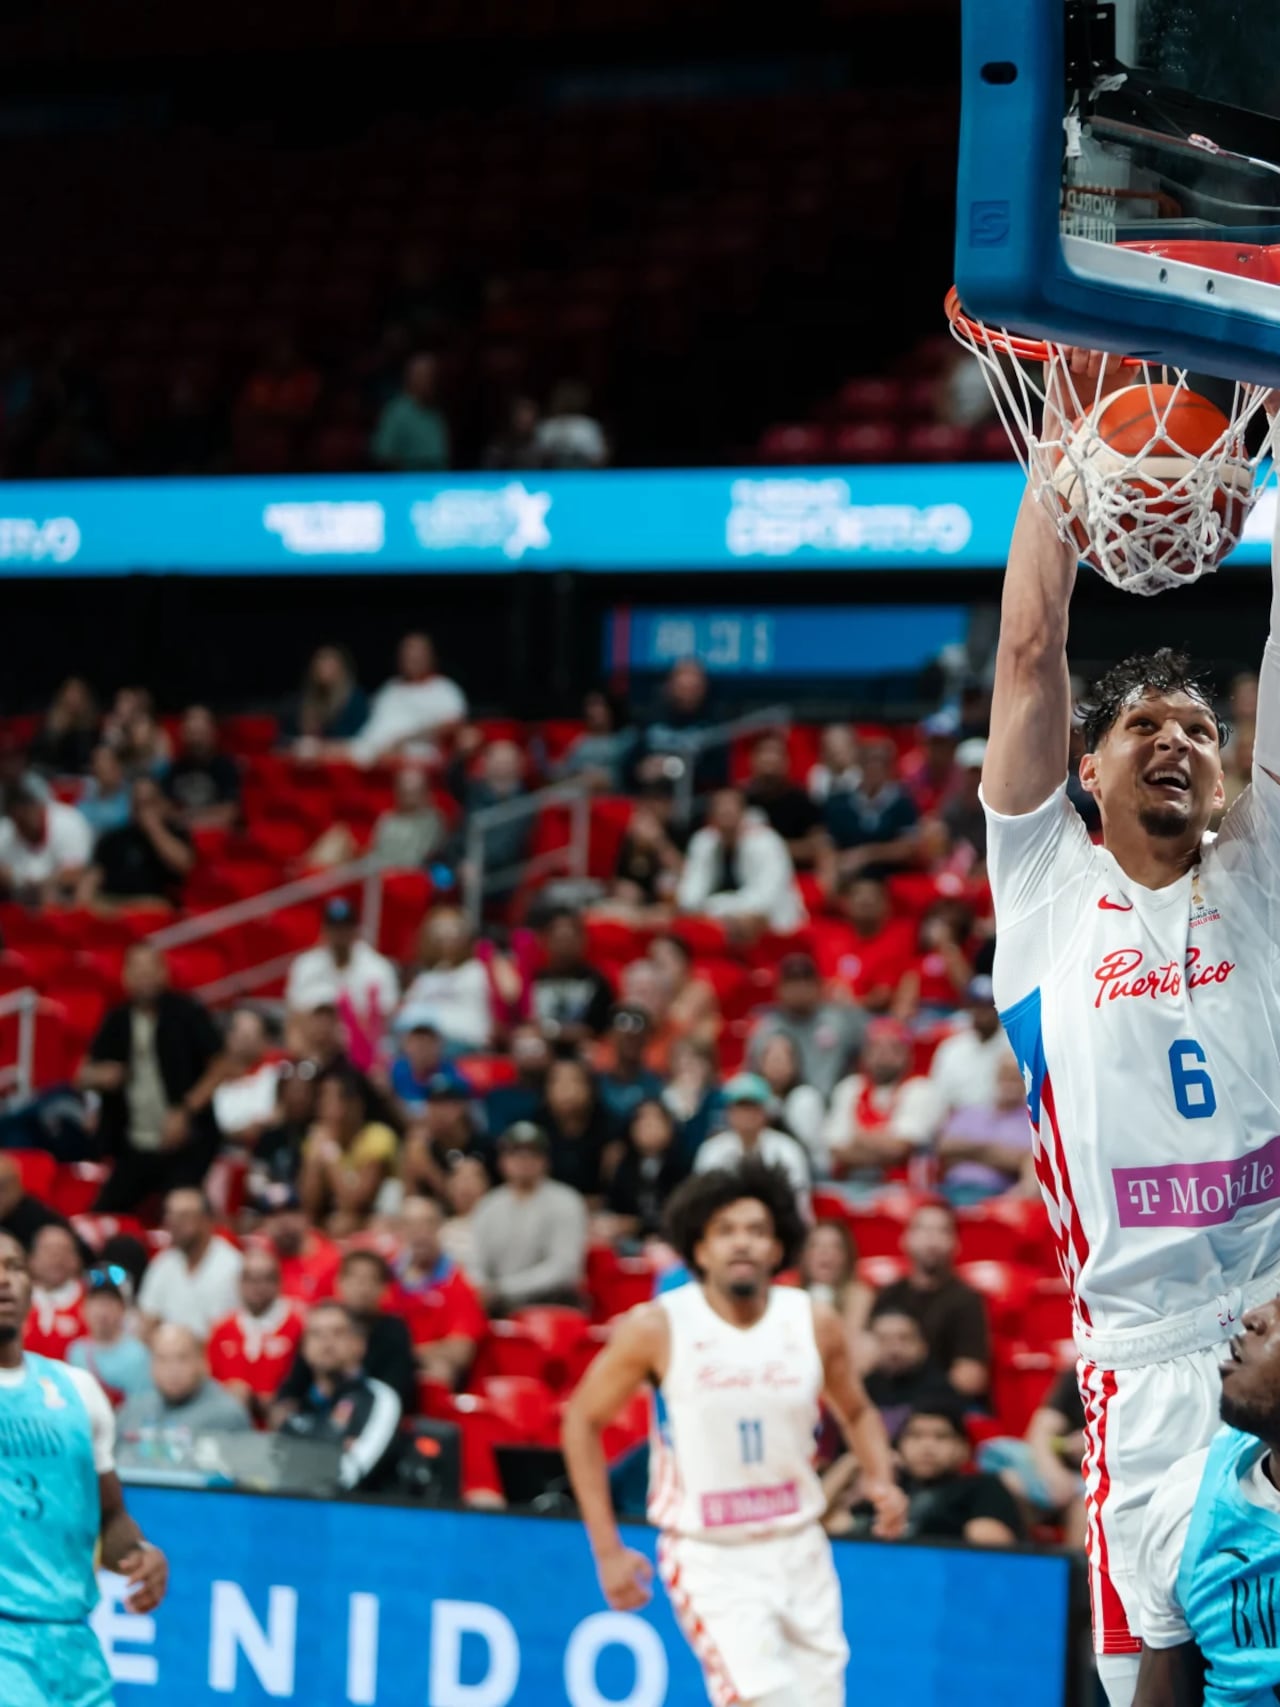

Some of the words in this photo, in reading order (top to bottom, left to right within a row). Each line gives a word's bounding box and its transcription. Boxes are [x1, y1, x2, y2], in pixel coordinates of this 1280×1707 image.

[1094, 948, 1181, 1008] Puerto
[1168, 1039, 1217, 1119] 6
[1166, 1161, 1274, 1214] Mobile
[738, 1417, 763, 1464] 11
[15, 1470, 44, 1522] 3
